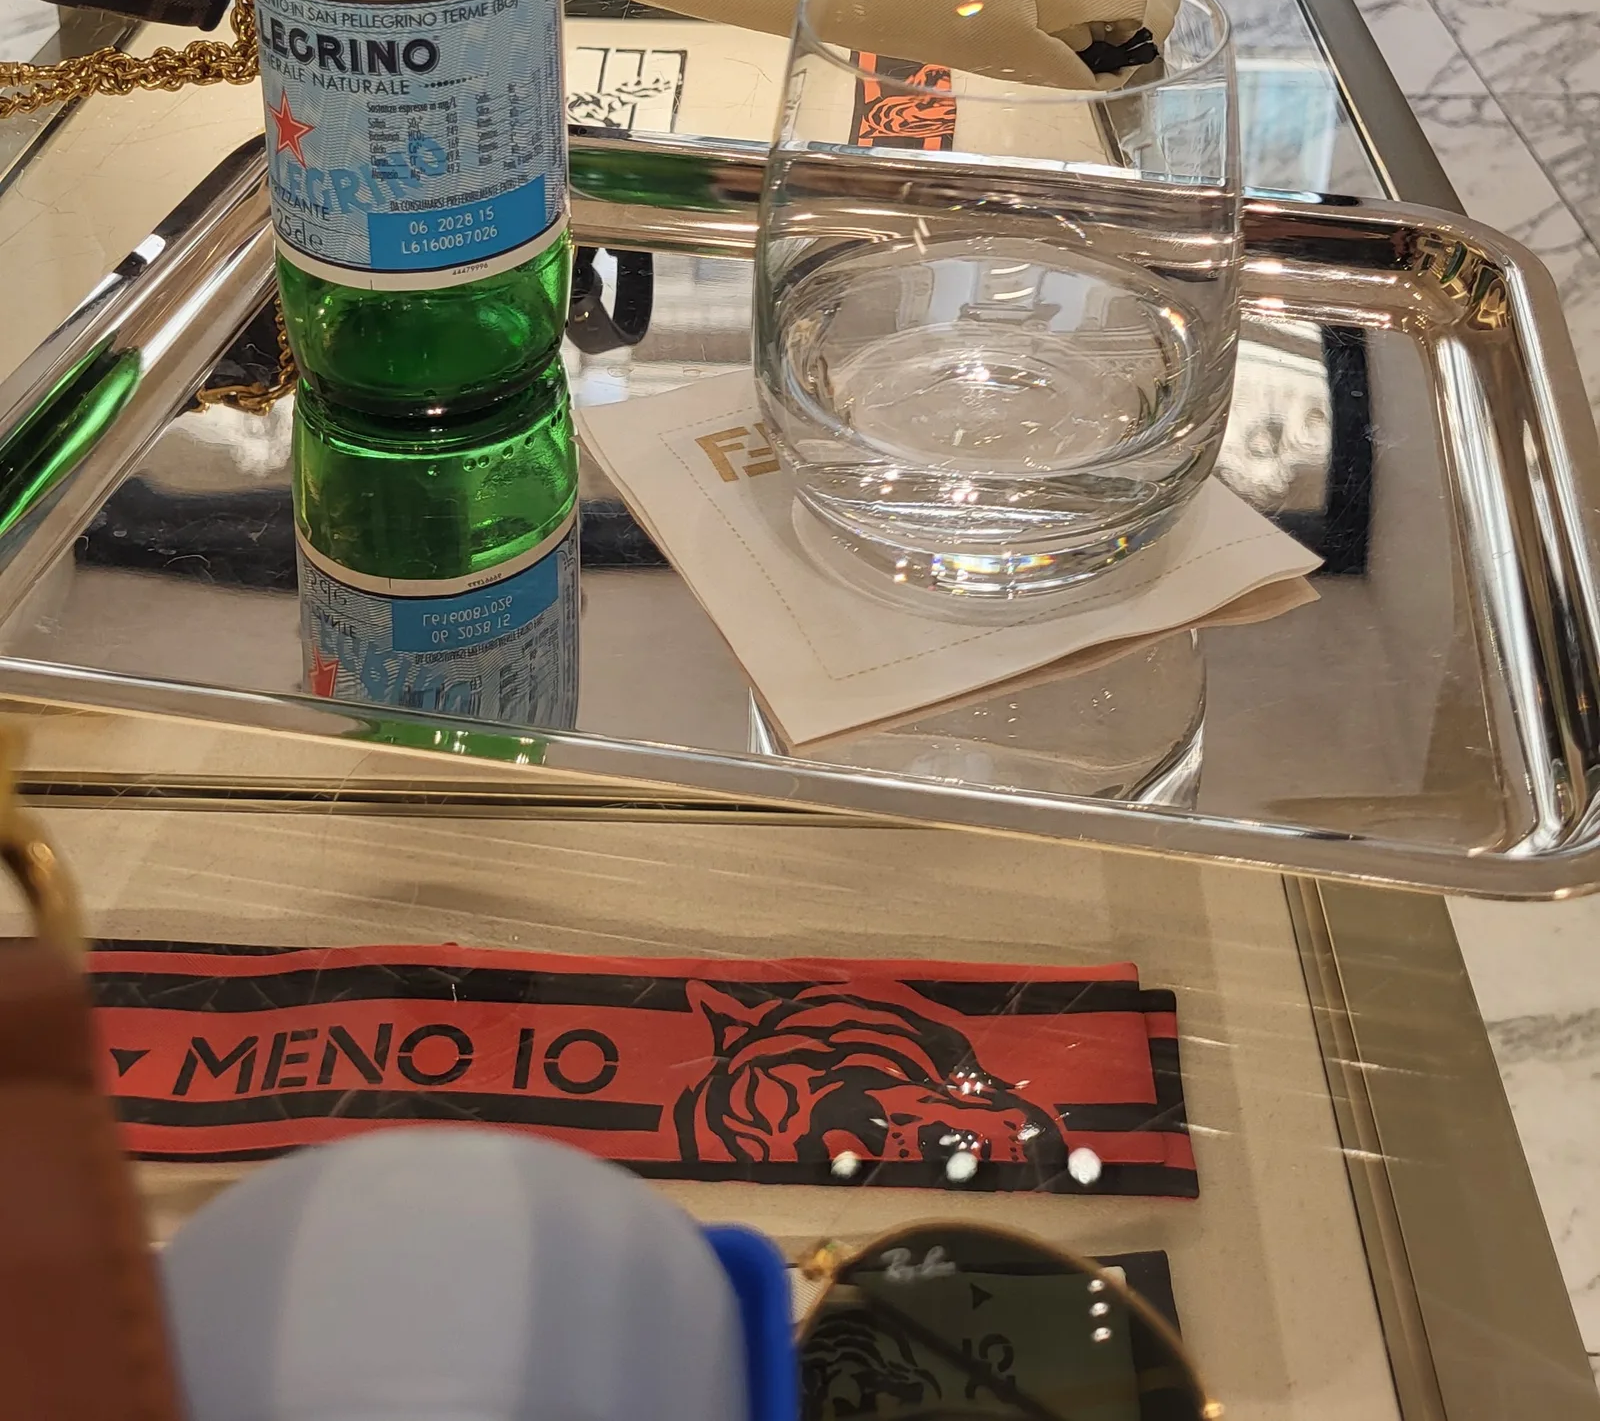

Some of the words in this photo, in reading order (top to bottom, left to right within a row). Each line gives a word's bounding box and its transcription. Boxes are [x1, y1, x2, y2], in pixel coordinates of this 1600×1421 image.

[292, 3, 305, 18] IN
[308, 7, 338, 26] SAN
[342, 11, 438, 29] PELLEGRINO
[443, 2, 489, 25] TERME
[312, 73, 411, 96] NATURALE
[409, 221, 429, 236] 06
[438, 213, 474, 233] 2028
[479, 206, 495, 222] 15
[402, 225, 498, 255] L6160087026
[452, 262, 489, 276] 44479996
[171, 1021, 476, 1097] MENO
[514, 1026, 621, 1095] IO
